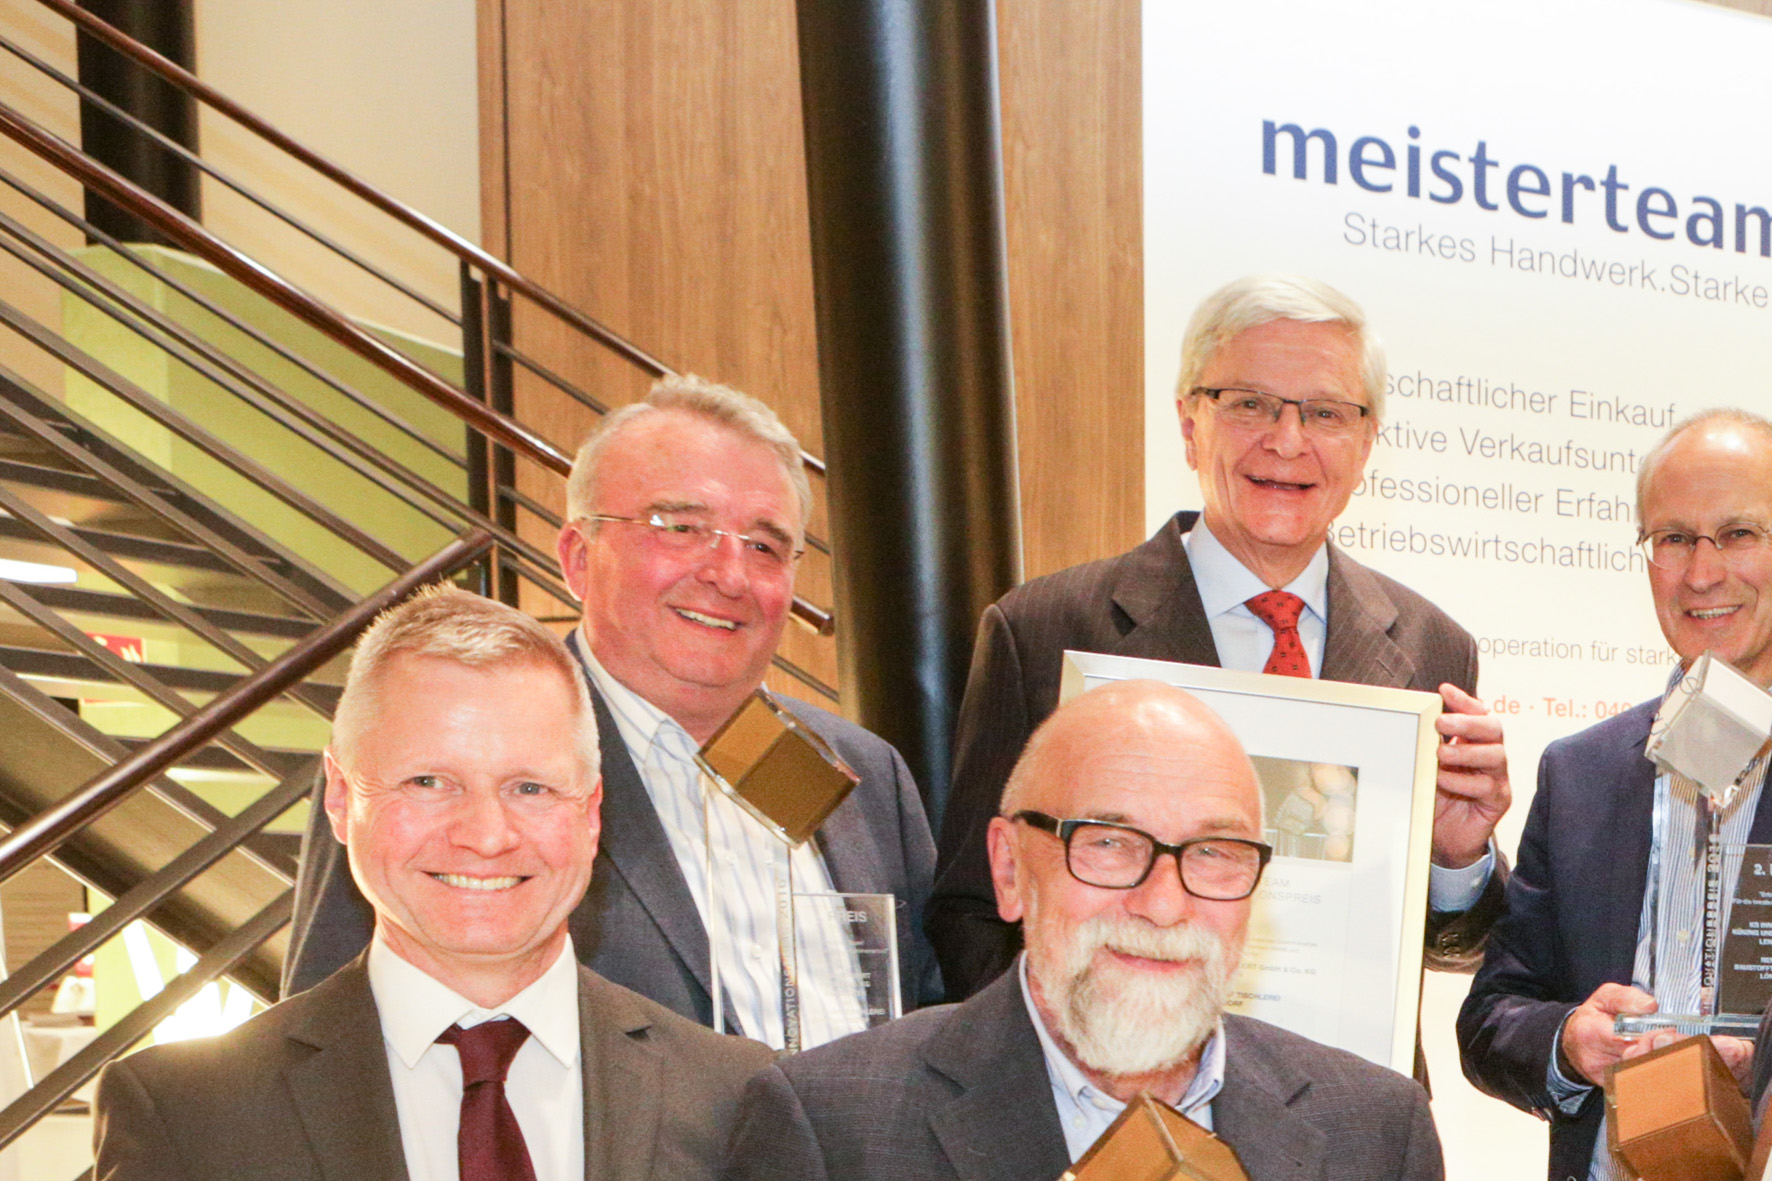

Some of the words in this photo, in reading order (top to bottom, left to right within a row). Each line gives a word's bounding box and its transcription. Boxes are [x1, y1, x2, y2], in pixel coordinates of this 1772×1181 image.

[1343, 211, 1476, 263] Starkes
[1569, 389, 1676, 429] Einkauf
[1458, 426, 1644, 475] Verkaufsunt
[1591, 640, 1619, 663] für
[1625, 645, 1680, 667] stark
[1542, 696, 1588, 719] Tel.:
[1753, 863, 1766, 876] 2.
